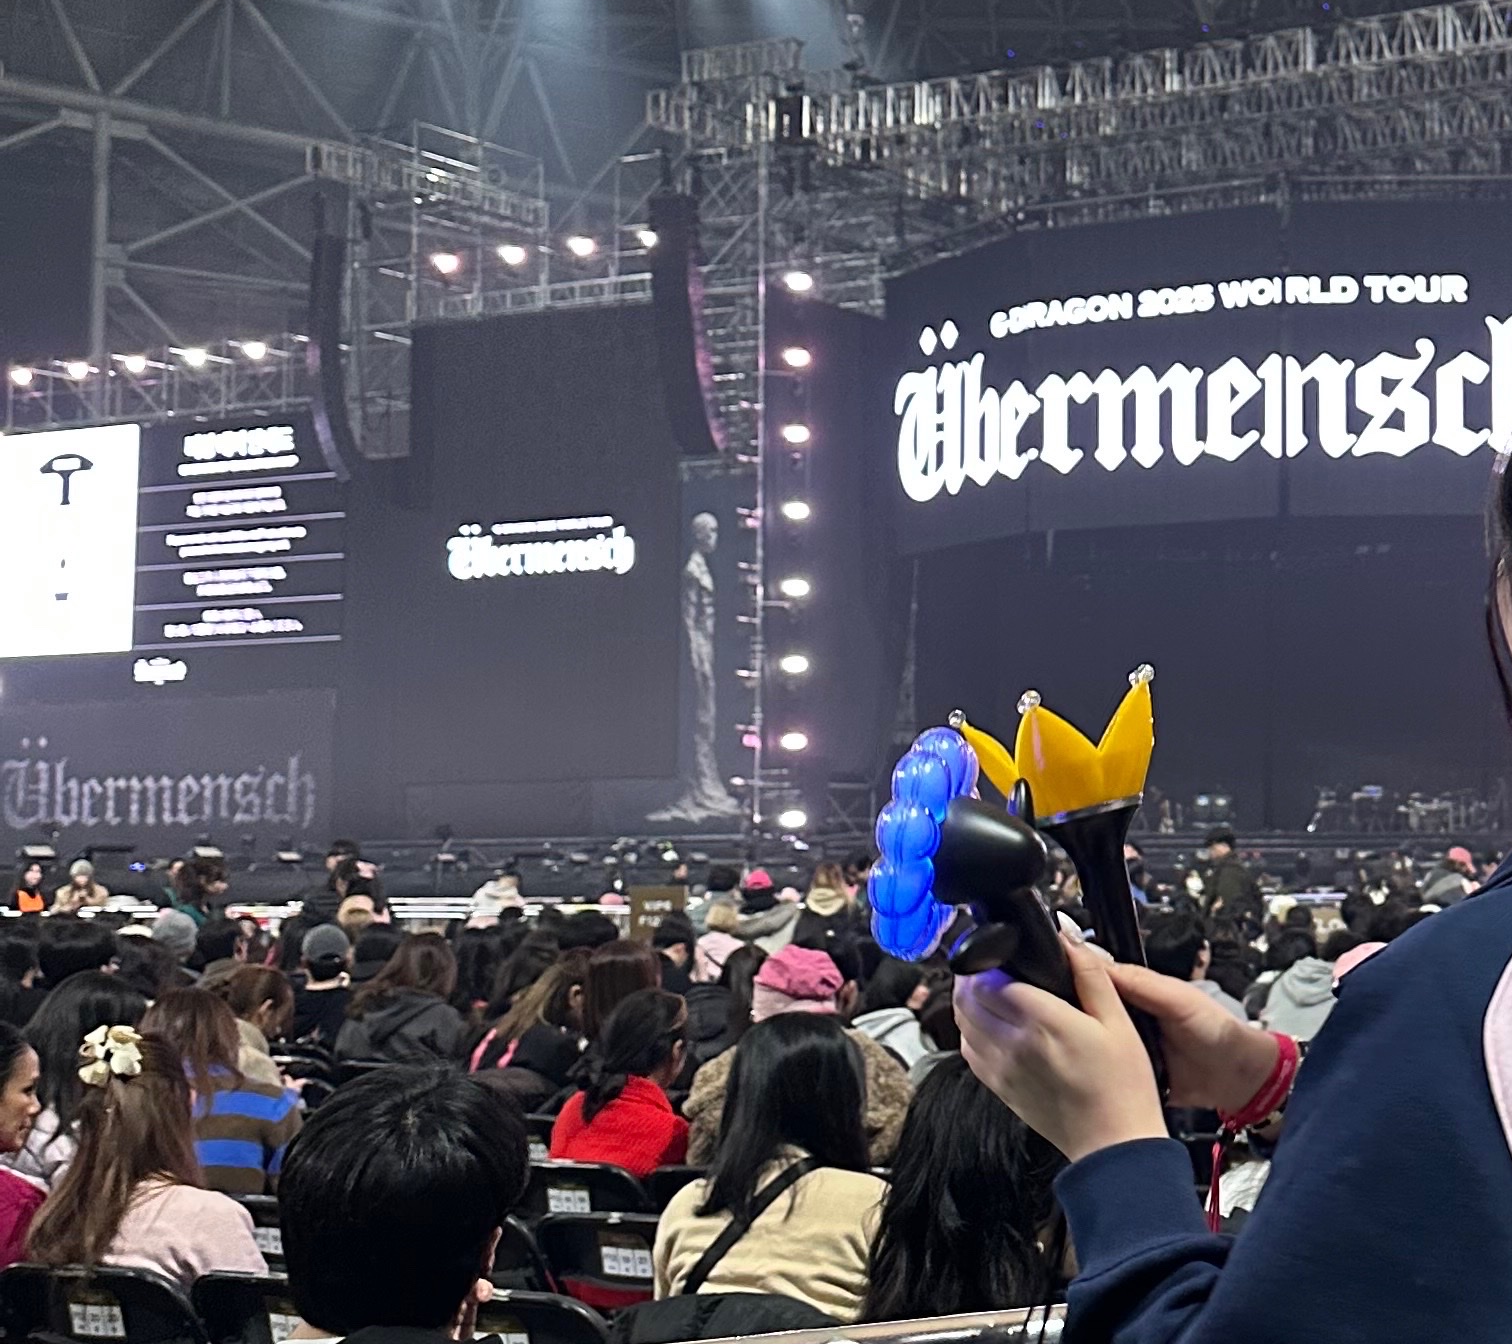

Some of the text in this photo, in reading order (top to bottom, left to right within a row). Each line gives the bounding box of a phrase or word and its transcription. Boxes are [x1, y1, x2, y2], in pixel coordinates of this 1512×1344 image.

[1137, 284, 1214, 318] 2025
[1218, 275, 1360, 309] WORLD
[1363, 274, 1468, 304] TOUR
[2, 736, 317, 829] Übermensch
